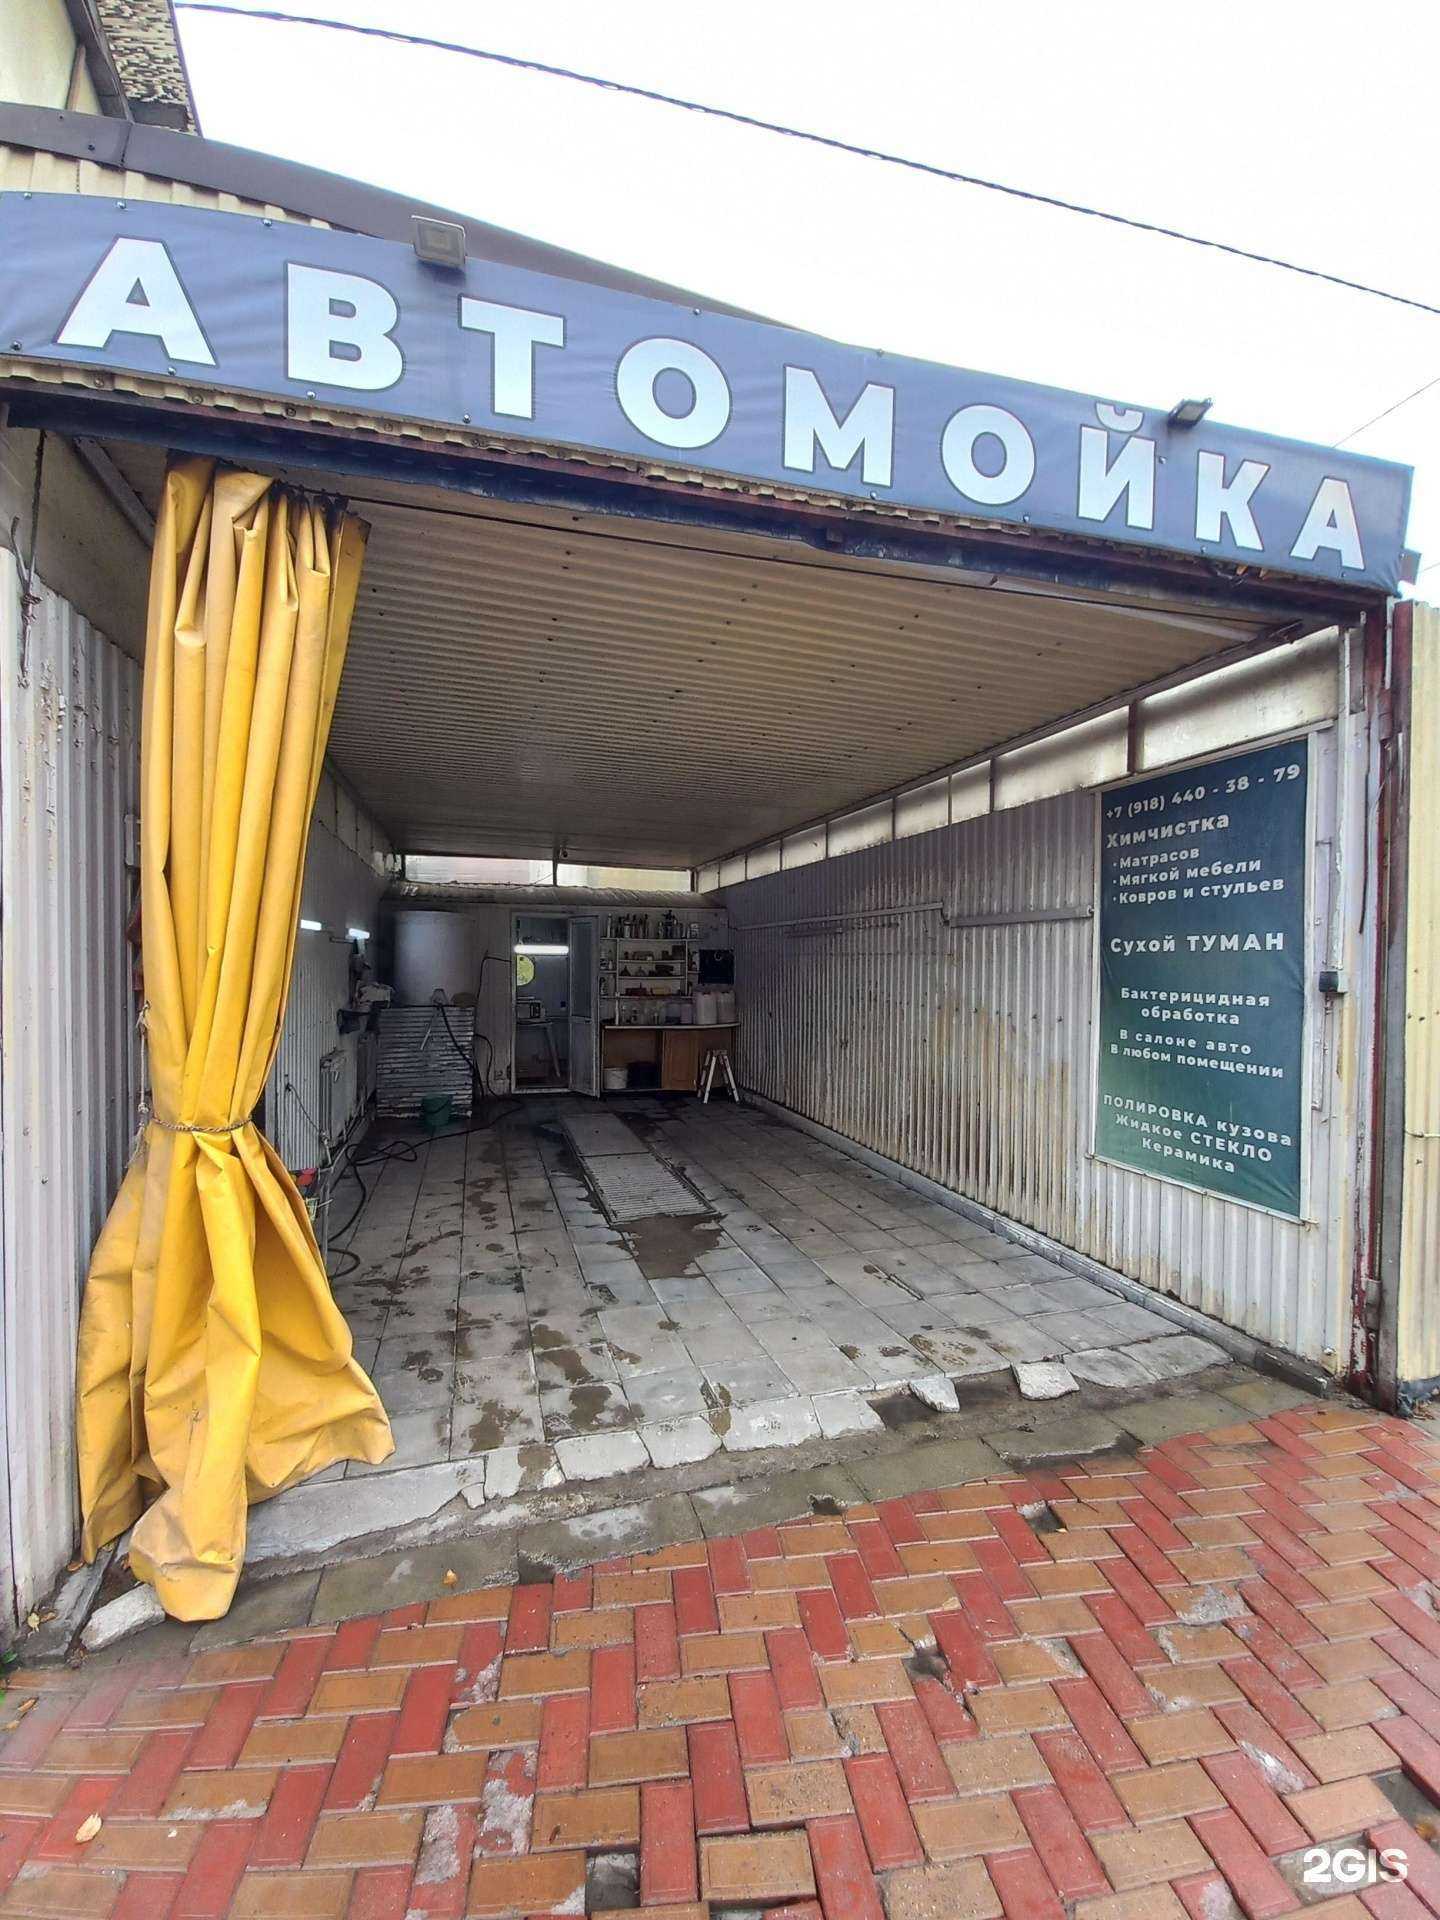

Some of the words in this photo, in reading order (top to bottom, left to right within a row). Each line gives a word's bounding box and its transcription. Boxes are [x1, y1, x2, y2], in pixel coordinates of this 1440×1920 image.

[54, 235, 1365, 571] АВТОМОЙКА
[1106, 806, 1122, 819] +7
[1128, 796, 1165, 818] (918)
[1171, 786, 1205, 804] 440
[1226, 776, 1250, 794] 38
[1273, 764, 1300, 783] 79
[1106, 814, 1230, 848] Химчистка
[1119, 848, 1200, 869] Матрасов
[1119, 867, 1179, 886] Мягкой
[1187, 859, 1261, 879] мебели
[1119, 887, 1177, 904] Ковров
[1183, 887, 1194, 899] и
[1200, 878, 1285, 898] стульев
[1110, 934, 1176, 956] Сухой
[1187, 932, 1284, 952] ТУМАН
[1121, 987, 1270, 1007] Бактерицидная
[1141, 1006, 1240, 1025] обработка
[1119, 1029, 1128, 1040] В
[1135, 1032, 1197, 1048] салоне
[1205, 1040, 1252, 1055] авто
[1110, 1044, 1119, 1054] В
[1123, 1046, 1171, 1062] любом
[1177, 1054, 1284, 1078] помещении
[1103, 1094, 1208, 1128] ПОЛИРОВКА
[1216, 1120, 1292, 1147] кузова
[1115, 1114, 1183, 1140] Жидкое
[1190, 1131, 1273, 1162] СТЕКЛО
[1142, 1137, 1235, 1173] Керамика
